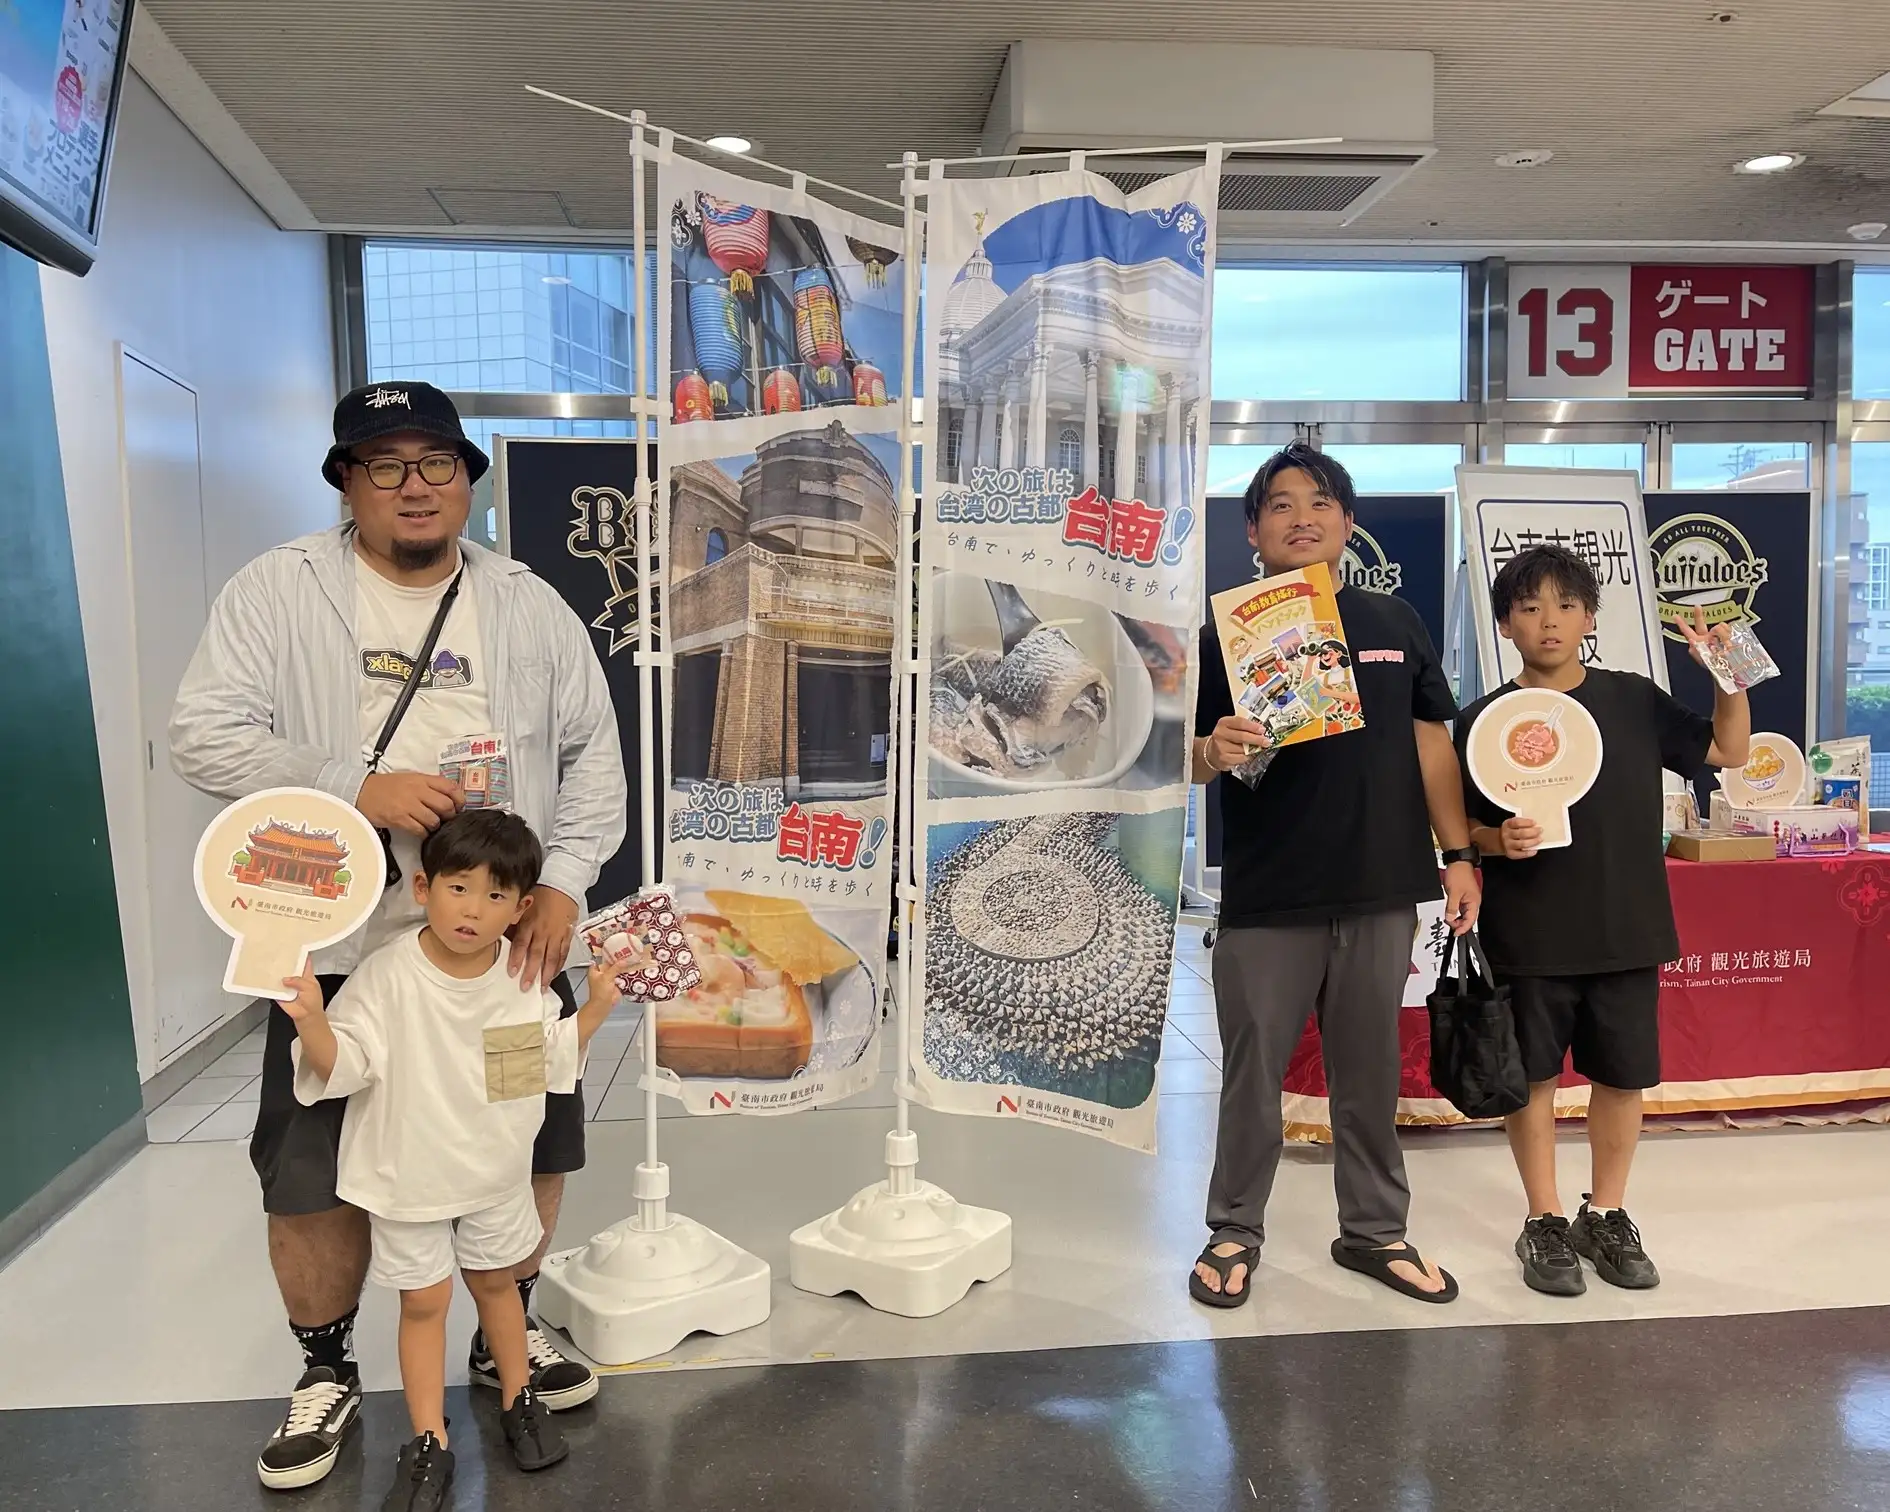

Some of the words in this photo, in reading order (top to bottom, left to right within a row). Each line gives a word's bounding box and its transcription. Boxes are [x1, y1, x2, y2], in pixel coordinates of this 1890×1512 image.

[1654, 280, 1767, 319] ゲート
[1518, 288, 1614, 377] 13
[1654, 329, 1785, 371] GATE
[971, 466, 1075, 494] 次の旅は
[936, 491, 1064, 524] 台湾の古都
[1675, 527, 1689, 537] ALL
[1691, 525, 1730, 544] TOGETHER
[1491, 528, 1631, 585] 台観光
[1684, 606, 1733, 619] BUALOES
[689, 783, 784, 813] 次の旅は
[681, 852, 873, 897] 南で、ゆっくりと時を歩く
[1711, 949, 1812, 972] 觀光旅遊局
[1659, 980, 1683, 988] rism,
[1684, 979, 1710, 987] Tainan
[1712, 976, 1730, 988] City
[1731, 975, 1783, 984] Government
